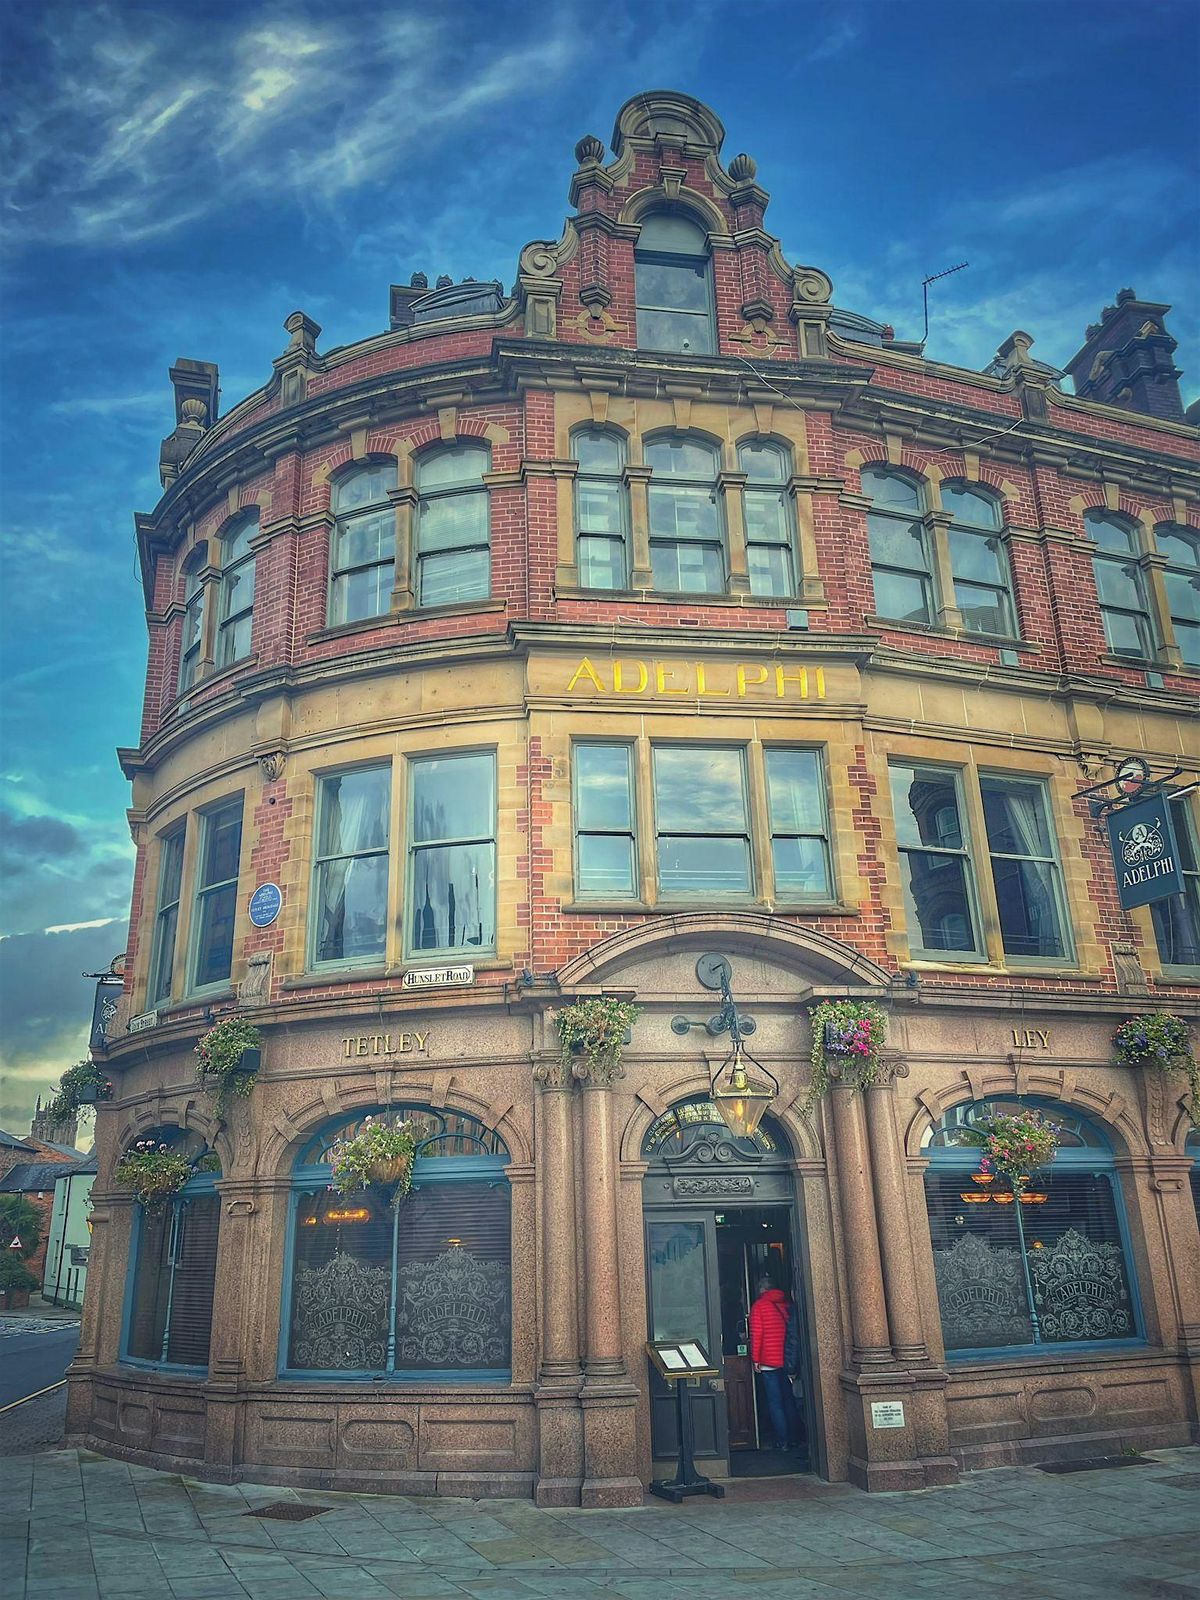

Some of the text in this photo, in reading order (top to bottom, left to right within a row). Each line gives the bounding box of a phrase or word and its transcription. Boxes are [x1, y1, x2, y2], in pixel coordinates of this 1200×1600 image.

[566, 656, 828, 699] ADELPHI
[1123, 856, 1175, 889] ADELPHI
[407, 971, 469, 985] HUNSLET ROAD
[342, 1031, 430, 1057] TETLEY
[1011, 1030, 1051, 1049] LEY
[956, 1286, 1002, 1306] ADELPHI
[1060, 1281, 1106, 1299] ADELPHI
[318, 1308, 367, 1328] ADELPHI
[427, 1303, 486, 1322] ADELPHI
